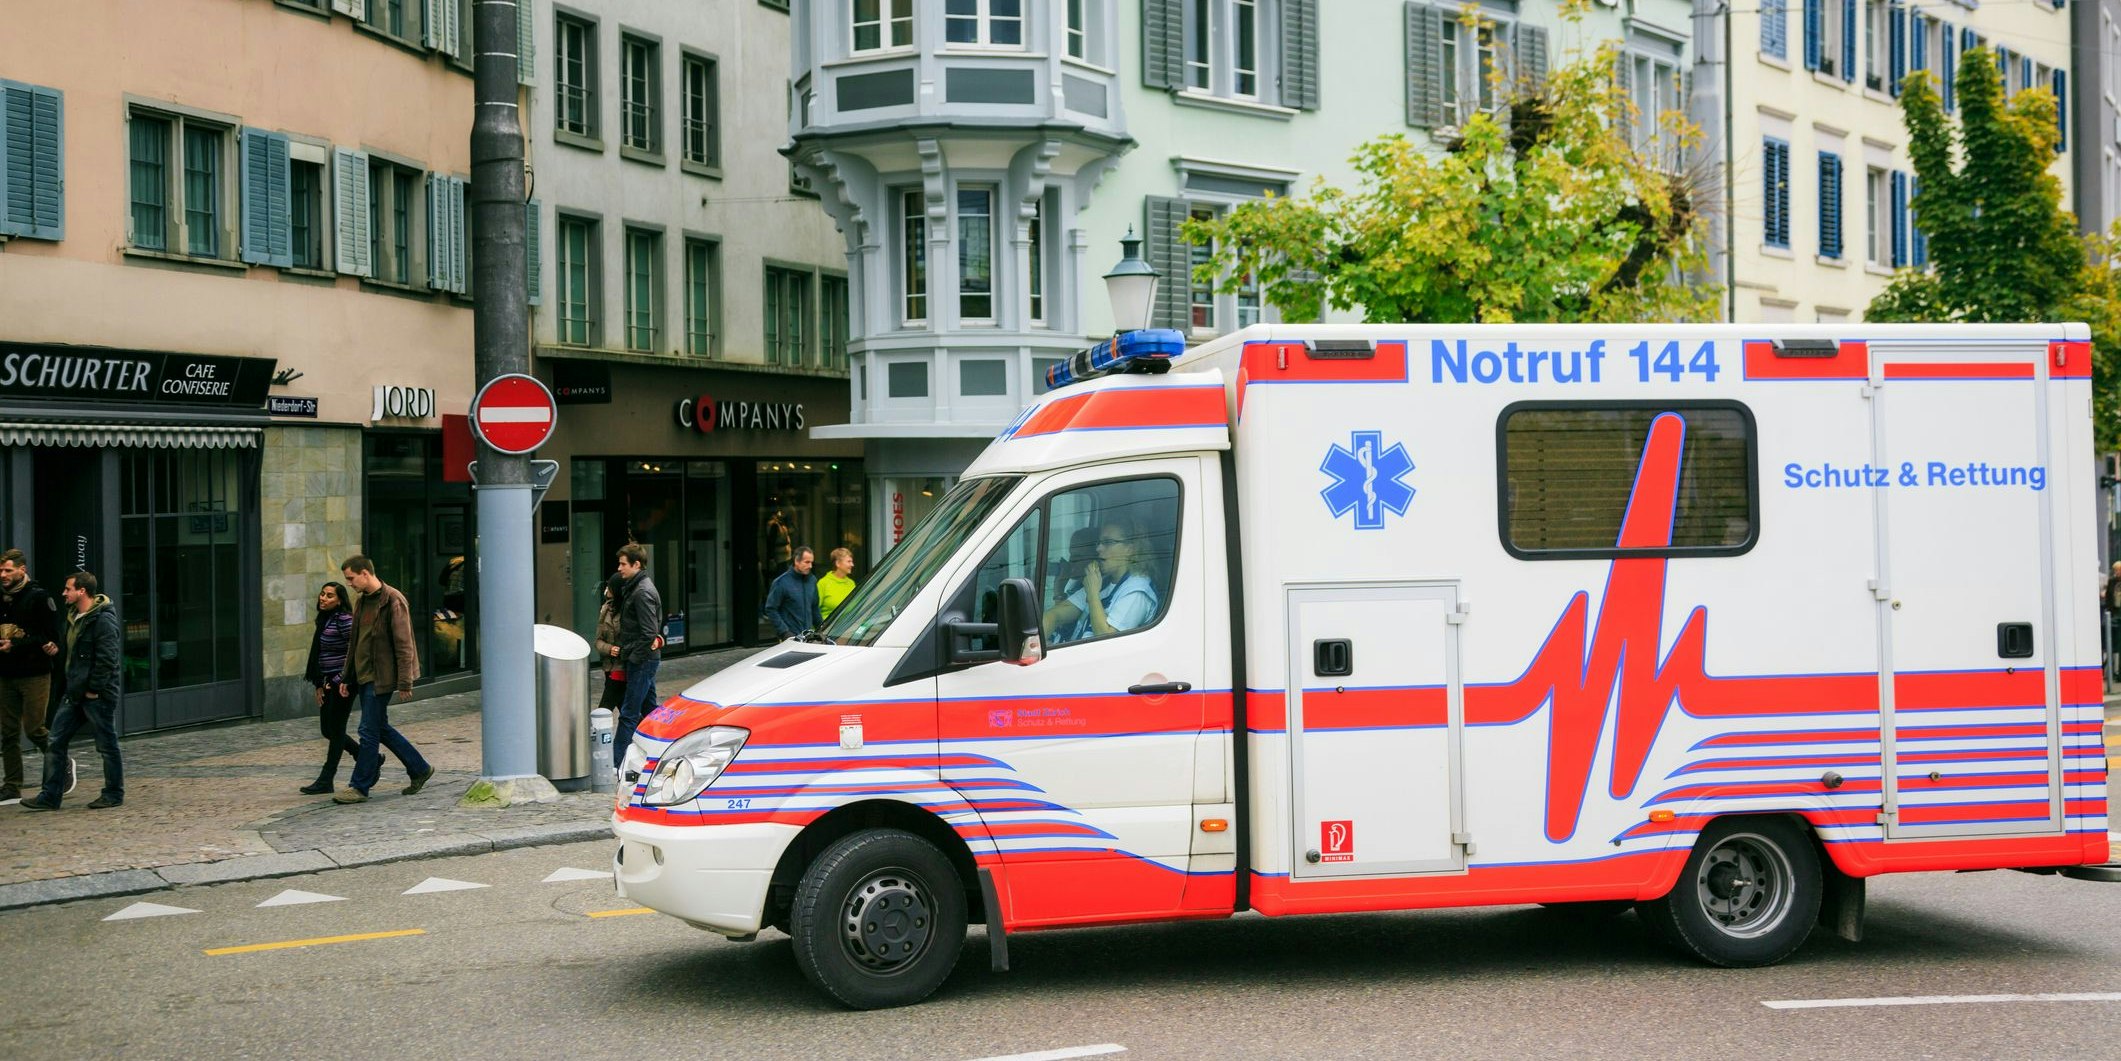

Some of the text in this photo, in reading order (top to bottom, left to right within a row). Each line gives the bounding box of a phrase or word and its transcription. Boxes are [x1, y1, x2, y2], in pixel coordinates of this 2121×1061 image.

[0, 353, 151, 391] SCHURTER
[185, 363, 216, 379] CAFE
[1431, 339, 1720, 384] Notruf 144
[161, 379, 231, 396] CONFISERIE
[371, 385, 436, 421] JORDI
[556, 386, 606, 396] COMPANYS
[679, 394, 805, 433] COMPANYS
[1784, 462, 2046, 491] Schutz & Rettung
[75, 535, 88, 572] Away
[728, 799, 751, 809] 247
